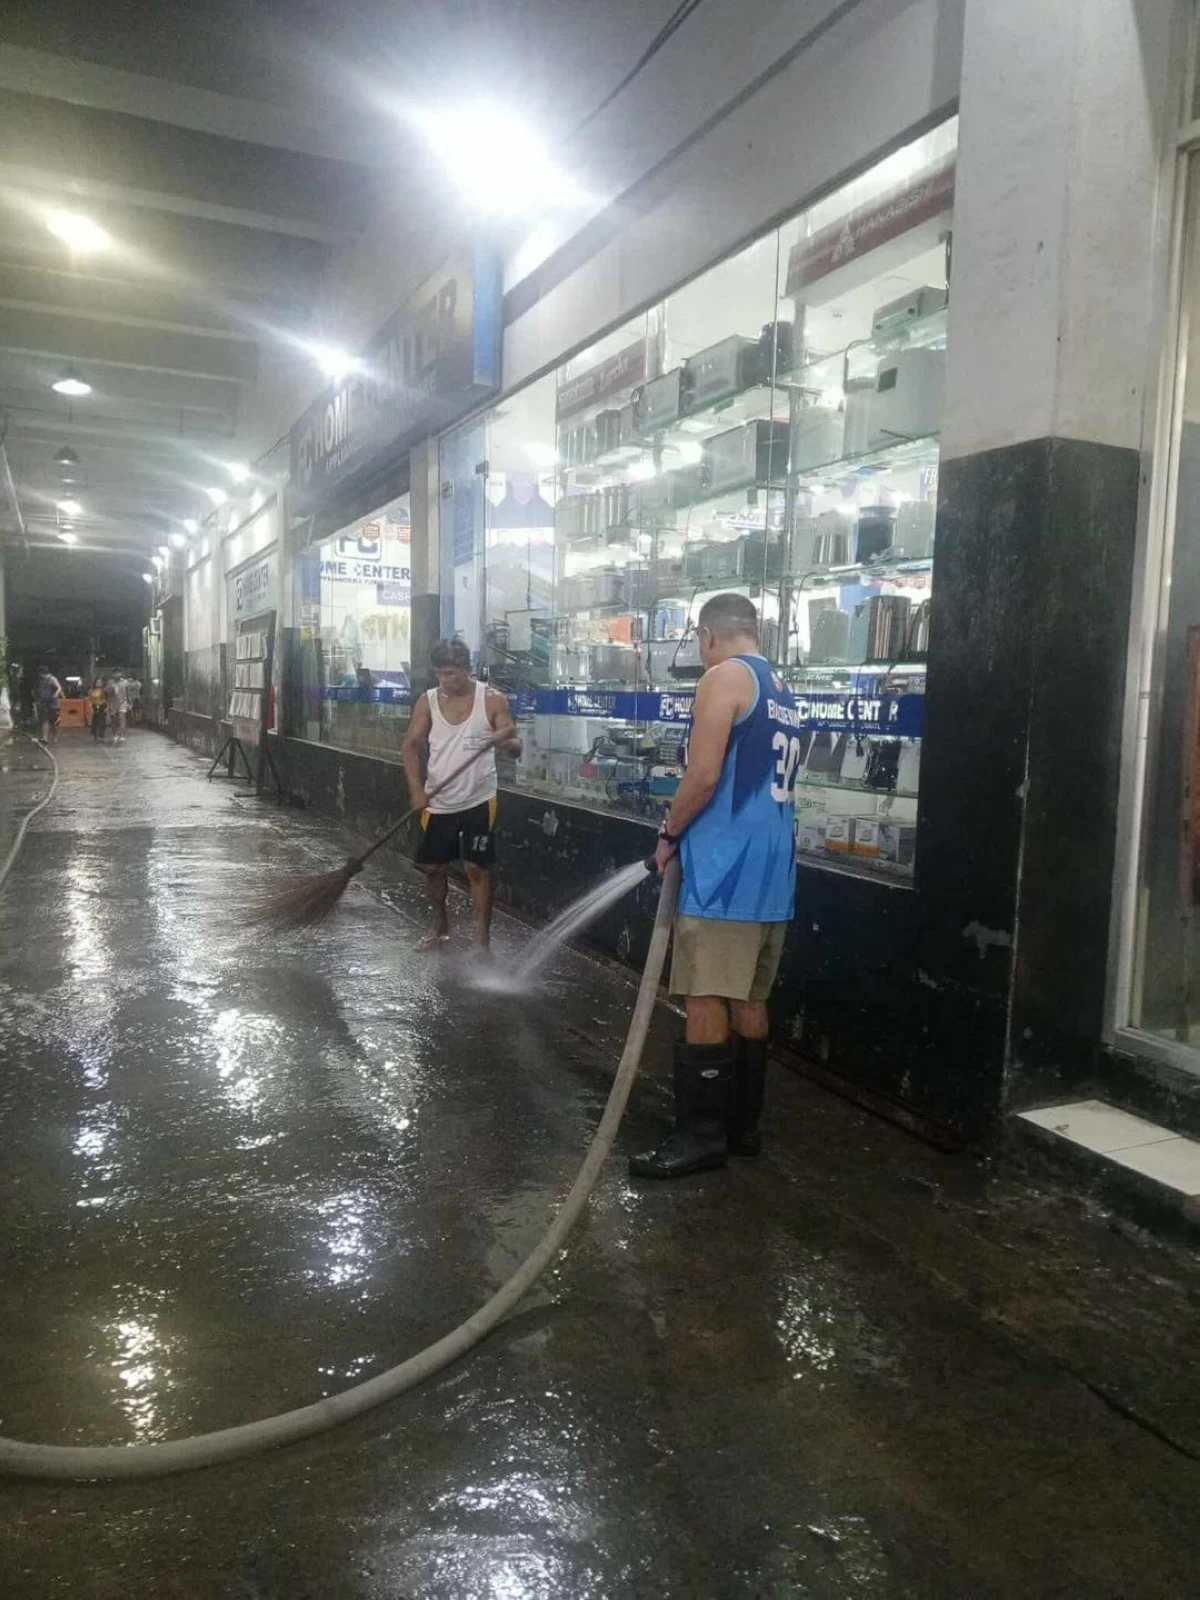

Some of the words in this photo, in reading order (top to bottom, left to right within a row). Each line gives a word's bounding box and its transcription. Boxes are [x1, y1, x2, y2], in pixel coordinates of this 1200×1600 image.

[674, 697, 695, 713] HOM
[811, 701, 845, 720] HOME
[847, 699, 899, 721] CENTR
